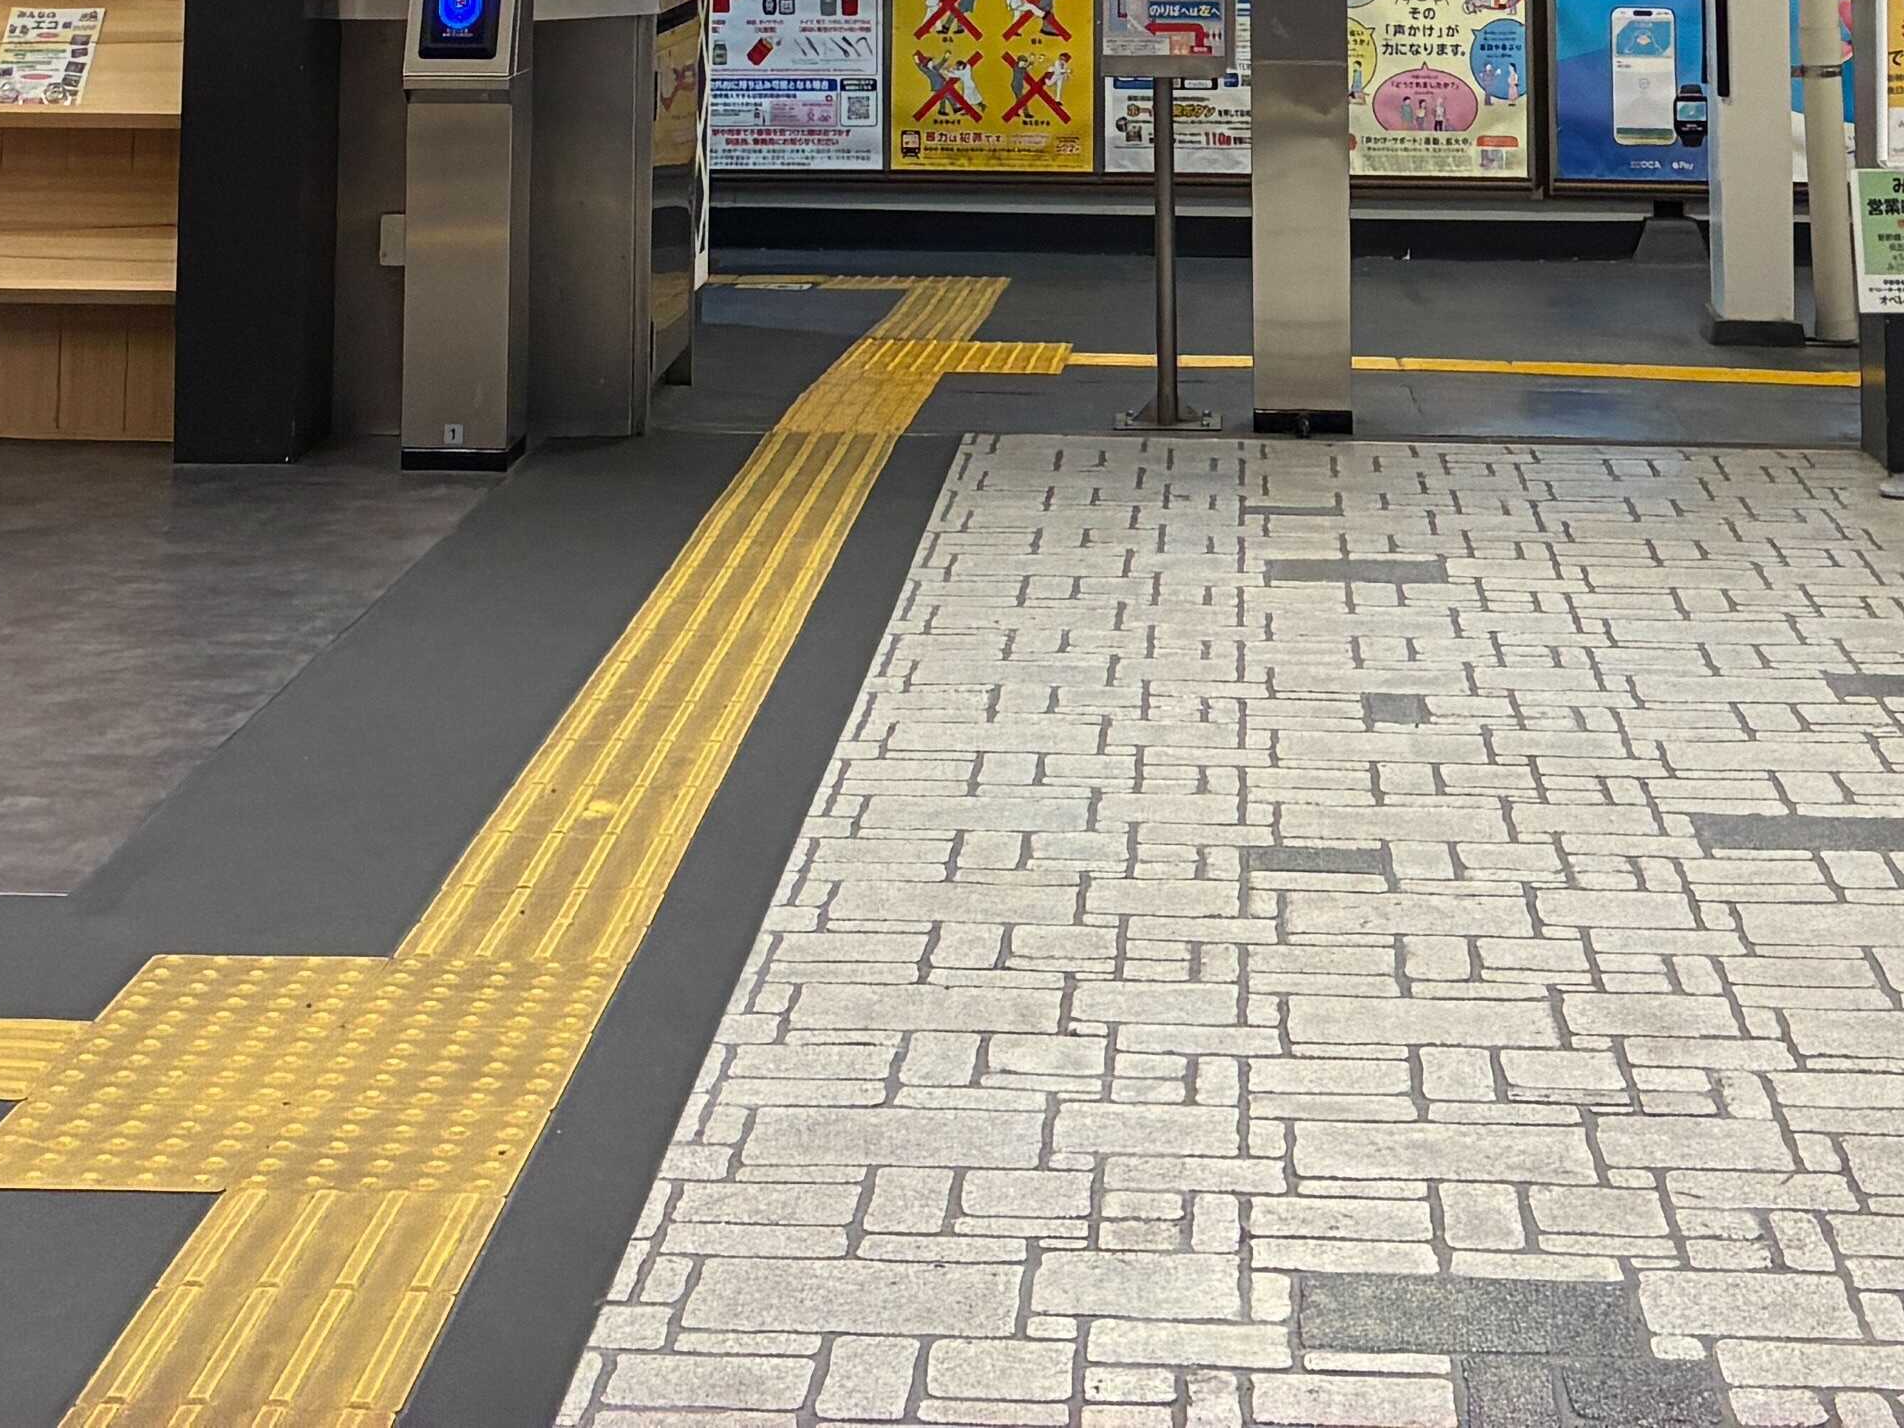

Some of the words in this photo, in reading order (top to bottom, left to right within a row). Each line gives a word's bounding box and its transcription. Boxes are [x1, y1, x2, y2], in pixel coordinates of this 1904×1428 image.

[1149, 5, 1221, 16] のりばへは左へ
[1408, 7, 1436, 20] その
[1384, 24, 1460, 38] 「声かけ」が
[1382, 43, 1466, 58] 力になります。
[449, 427, 457, 441] 1
